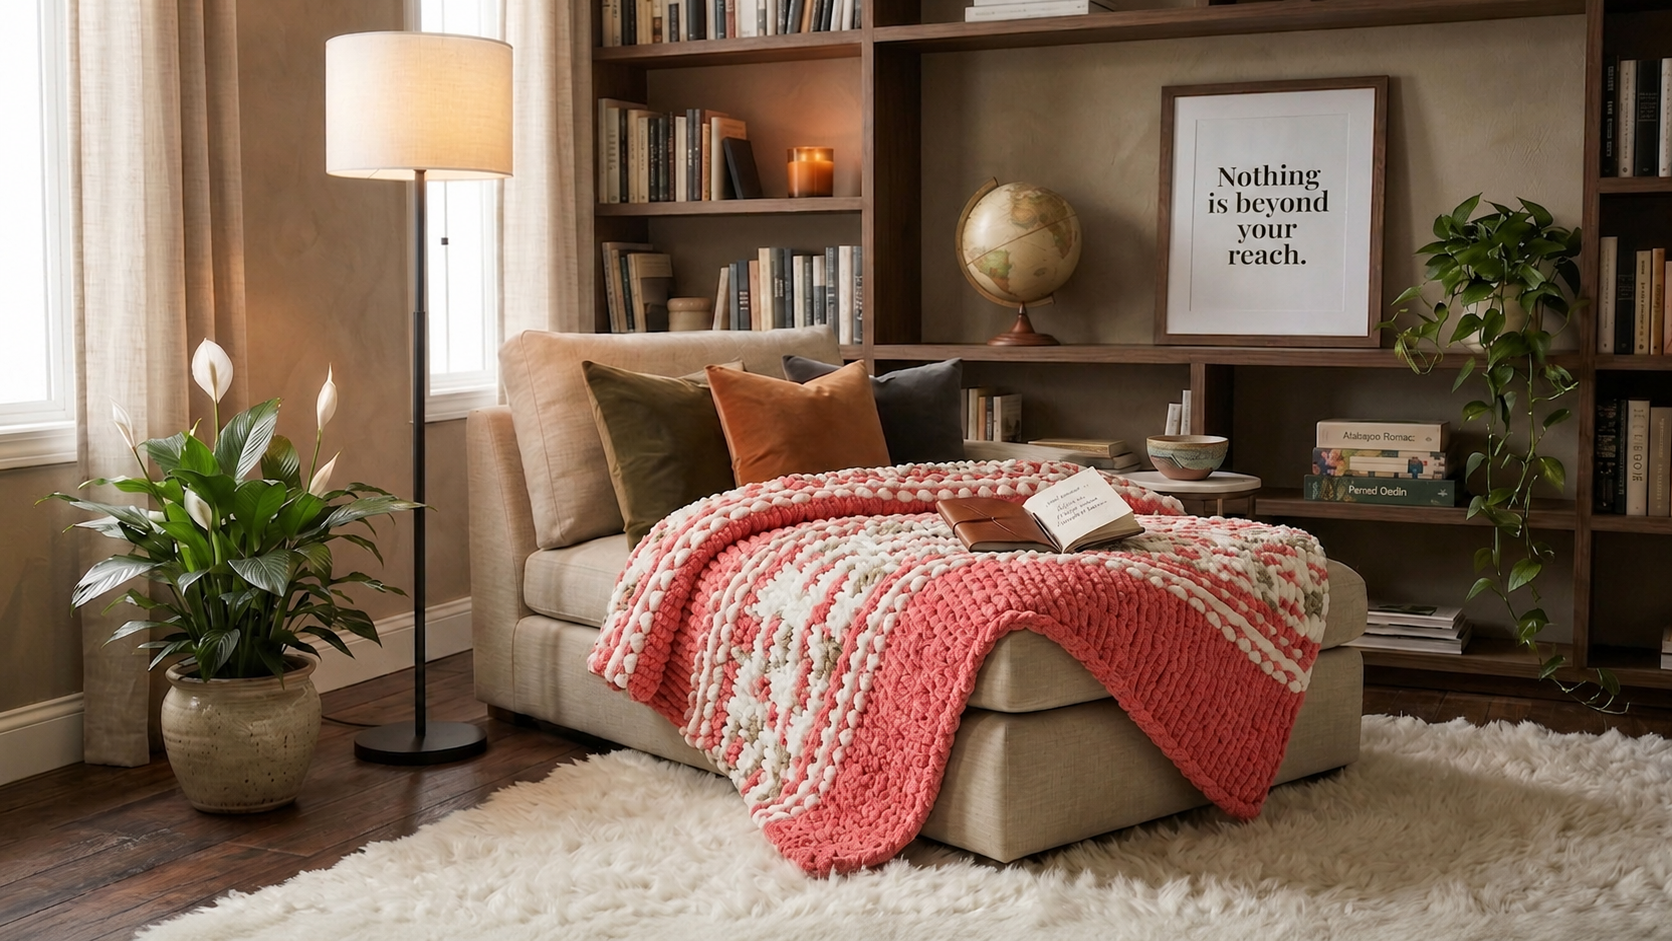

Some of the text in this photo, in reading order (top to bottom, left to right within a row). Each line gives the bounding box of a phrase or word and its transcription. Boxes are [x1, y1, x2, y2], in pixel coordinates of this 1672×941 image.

[1217, 164, 1321, 190] Nothing
[1208, 190, 1330, 217] is beyond
[1237, 222, 1297, 243] your
[1228, 243, 1307, 265] reach.
